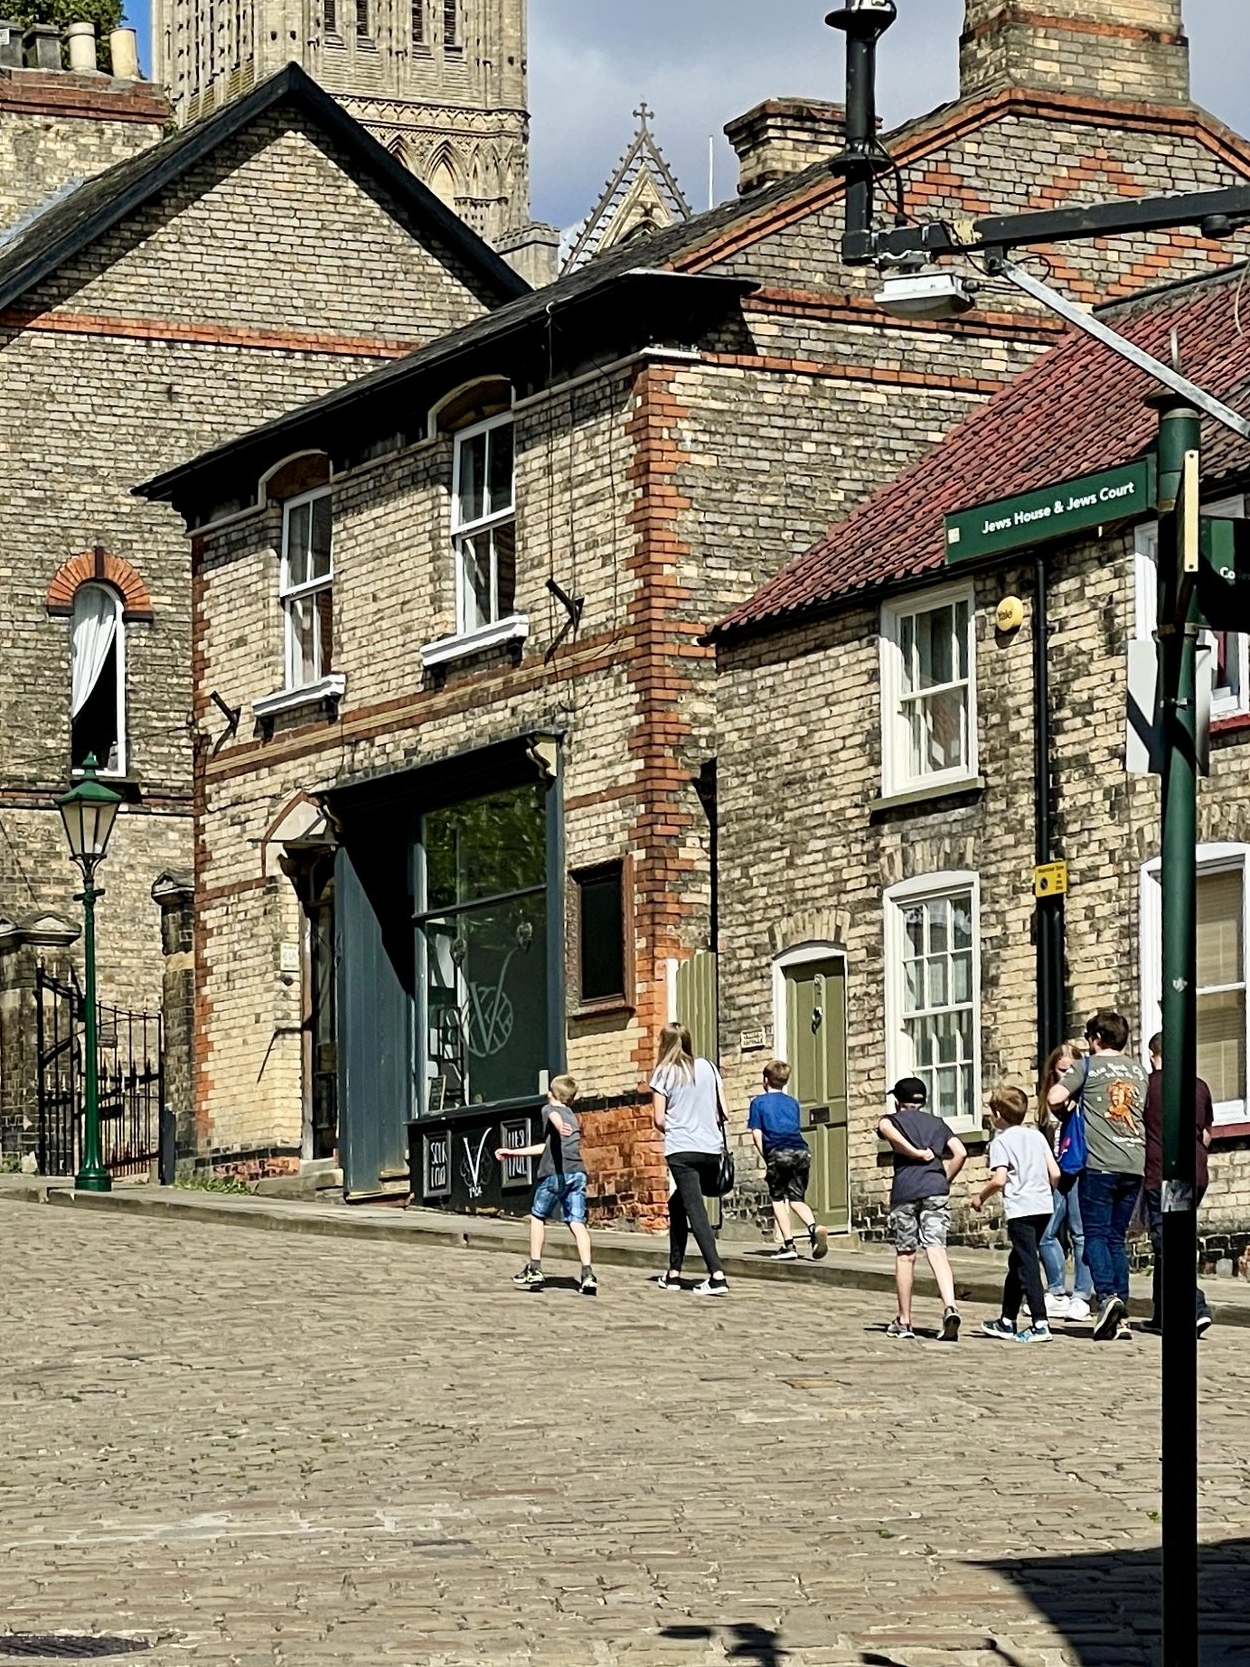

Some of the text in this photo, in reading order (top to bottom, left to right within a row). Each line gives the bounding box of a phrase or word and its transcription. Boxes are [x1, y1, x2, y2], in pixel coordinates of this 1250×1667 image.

[982, 482, 1135, 534] Jews House & Jews Court
